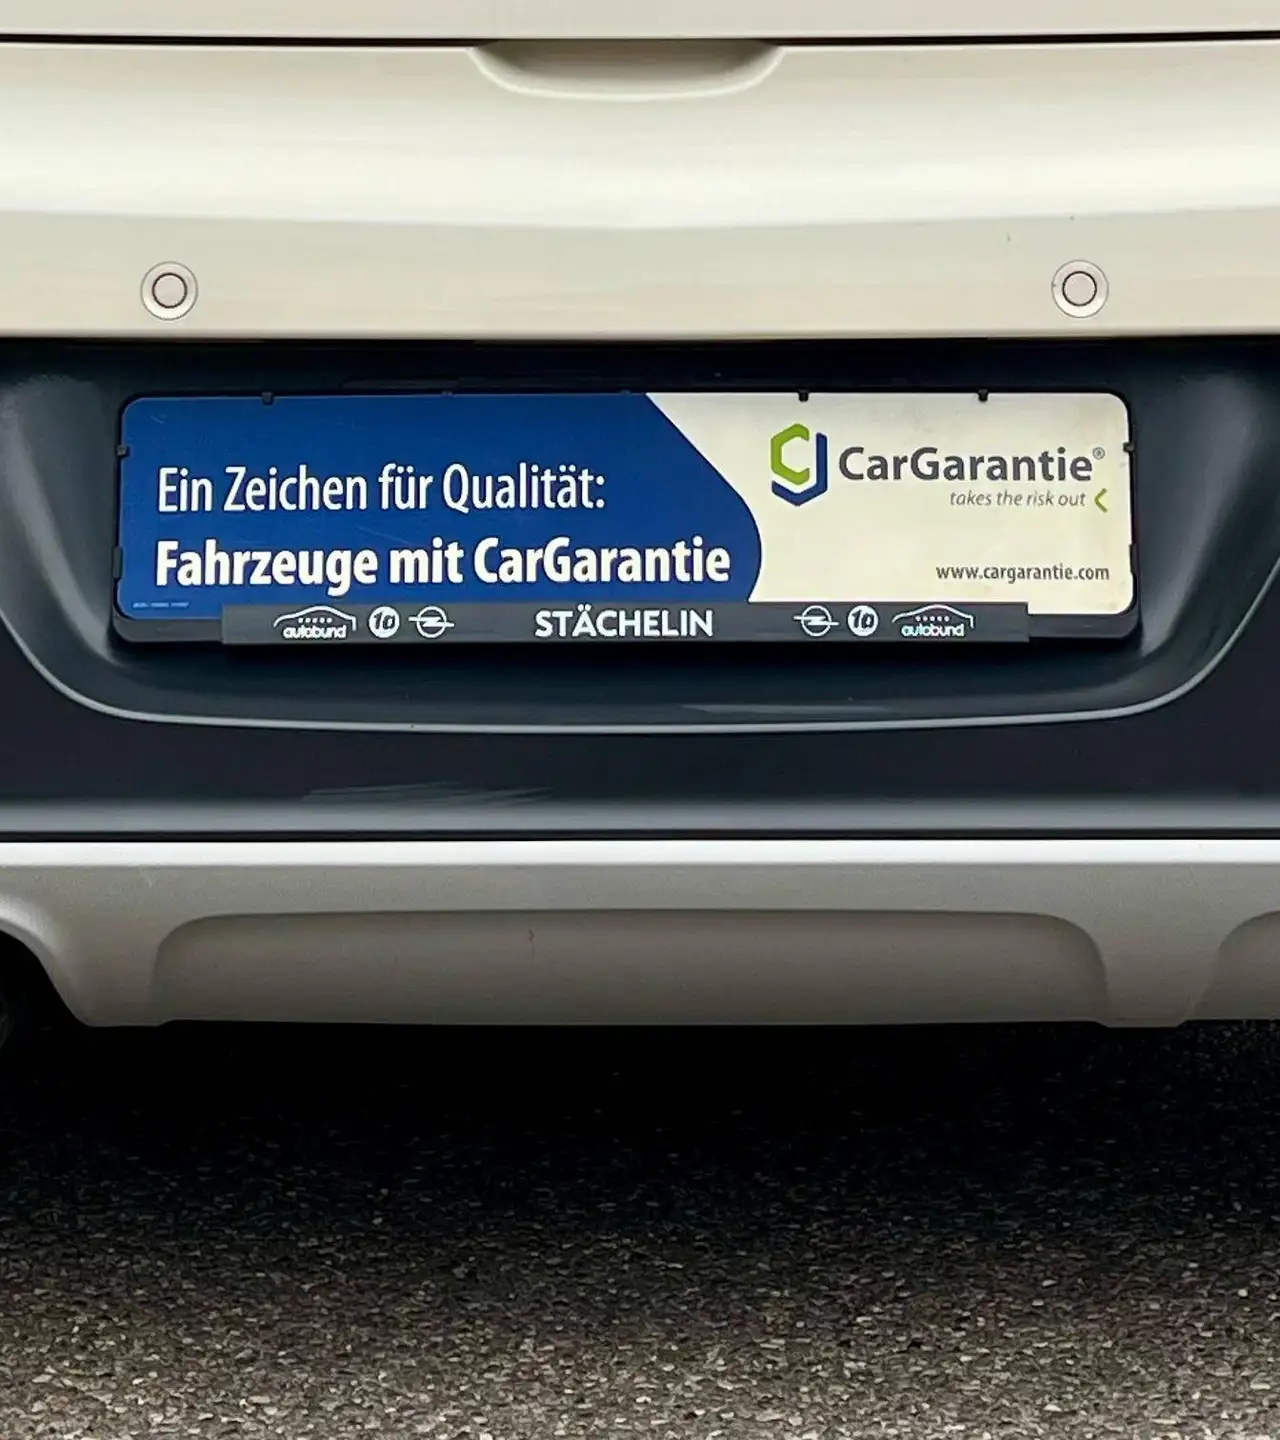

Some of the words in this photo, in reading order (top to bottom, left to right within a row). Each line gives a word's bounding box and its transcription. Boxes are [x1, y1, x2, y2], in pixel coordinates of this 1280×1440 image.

[158, 466, 213, 513] Ein
[223, 464, 368, 511] Zeichen
[378, 463, 434, 511] für
[442, 462, 606, 514] Qualität:
[949, 490, 993, 507] takes
[996, 490, 1022, 507] the
[1025, 490, 1055, 507] risk
[1057, 491, 1087, 507] out
[155, 538, 379, 597] Fahrzeuge
[389, 536, 465, 585] mit
[473, 535, 732, 584] CarGarantie
[935, 563, 1110, 584] www.cargarantie.com
[534, 603, 714, 638] STÄCHELIN
[901, 623, 965, 638] autobund
[282, 624, 347, 639] autobund
